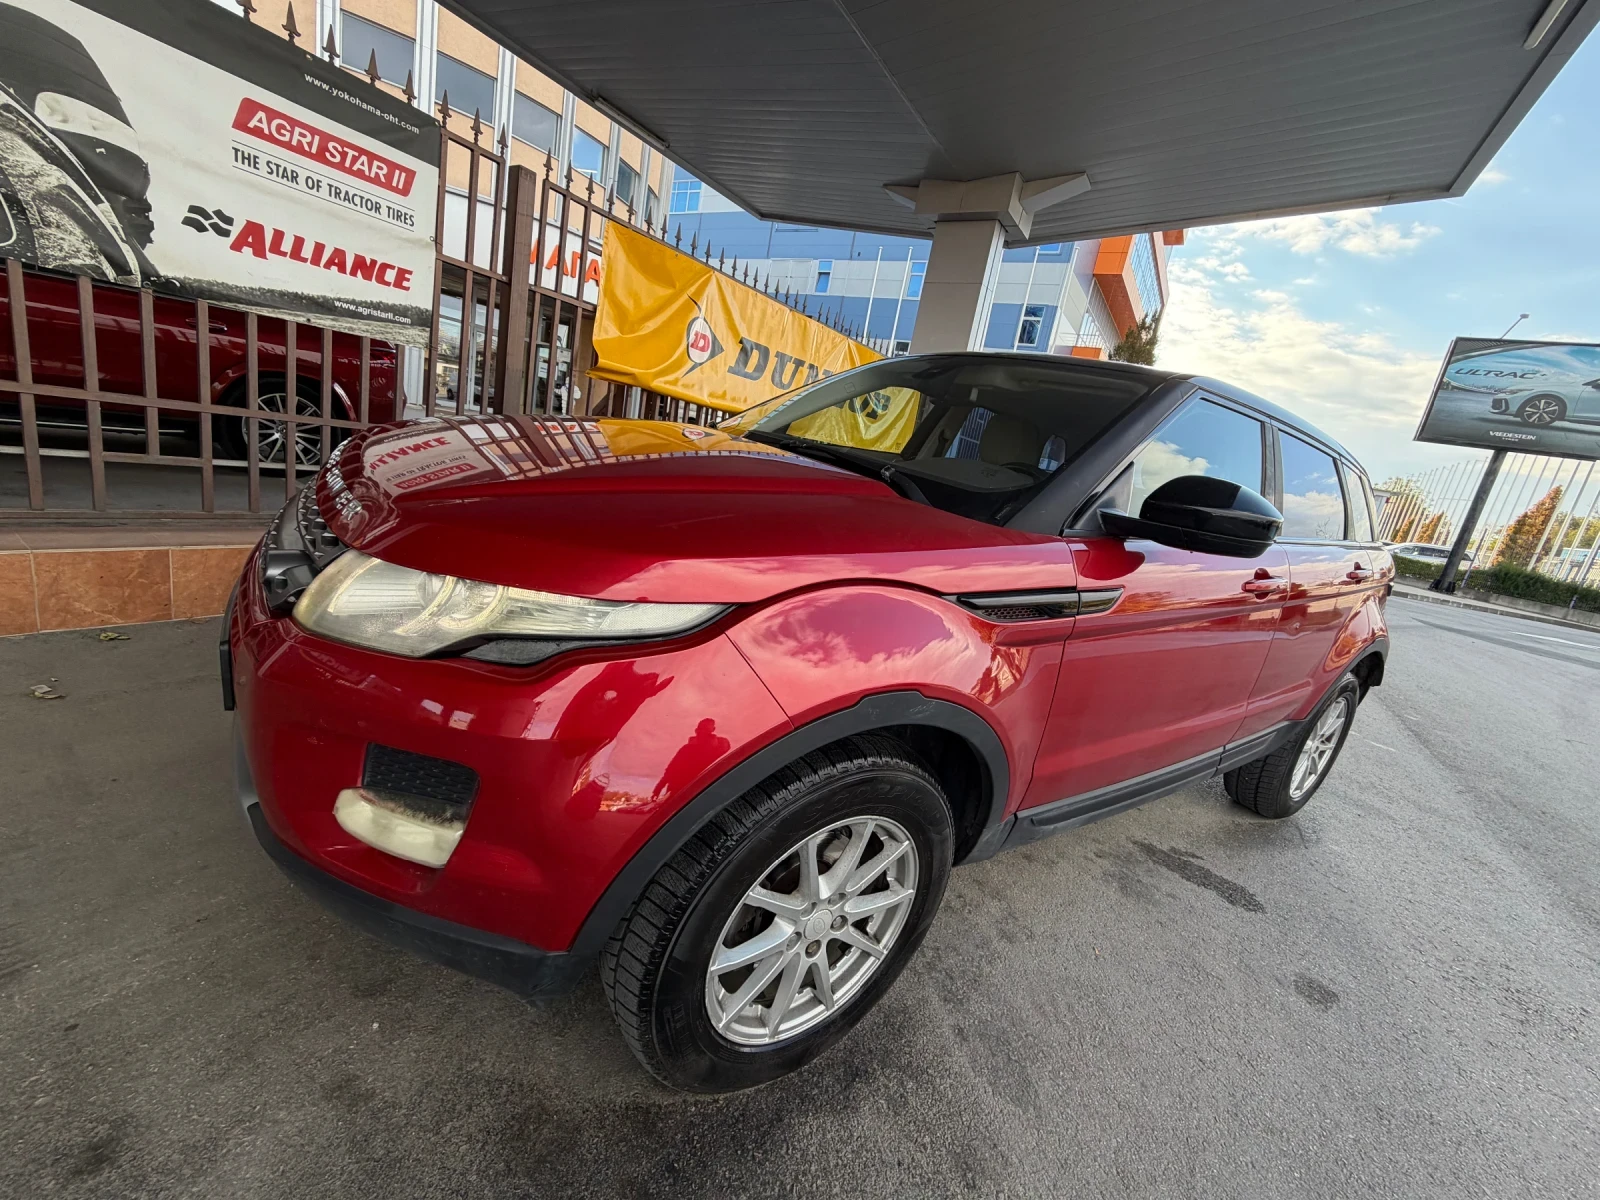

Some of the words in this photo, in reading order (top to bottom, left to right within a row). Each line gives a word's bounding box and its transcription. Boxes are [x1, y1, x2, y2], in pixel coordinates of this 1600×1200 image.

[304, 73, 420, 135] www.yokohama-oht.com
[231, 146, 260, 171] THE
[266, 159, 300, 186] STAR
[305, 175, 323, 193] OF
[327, 183, 382, 216] TRACTOR
[386, 205, 415, 228] TIRES
[247, 110, 320, 155] AGRI
[325, 141, 388, 183] STAR
[391, 169, 407, 190] II
[229, 218, 414, 292] ALLIANCE
[690, 329, 711, 353] D
